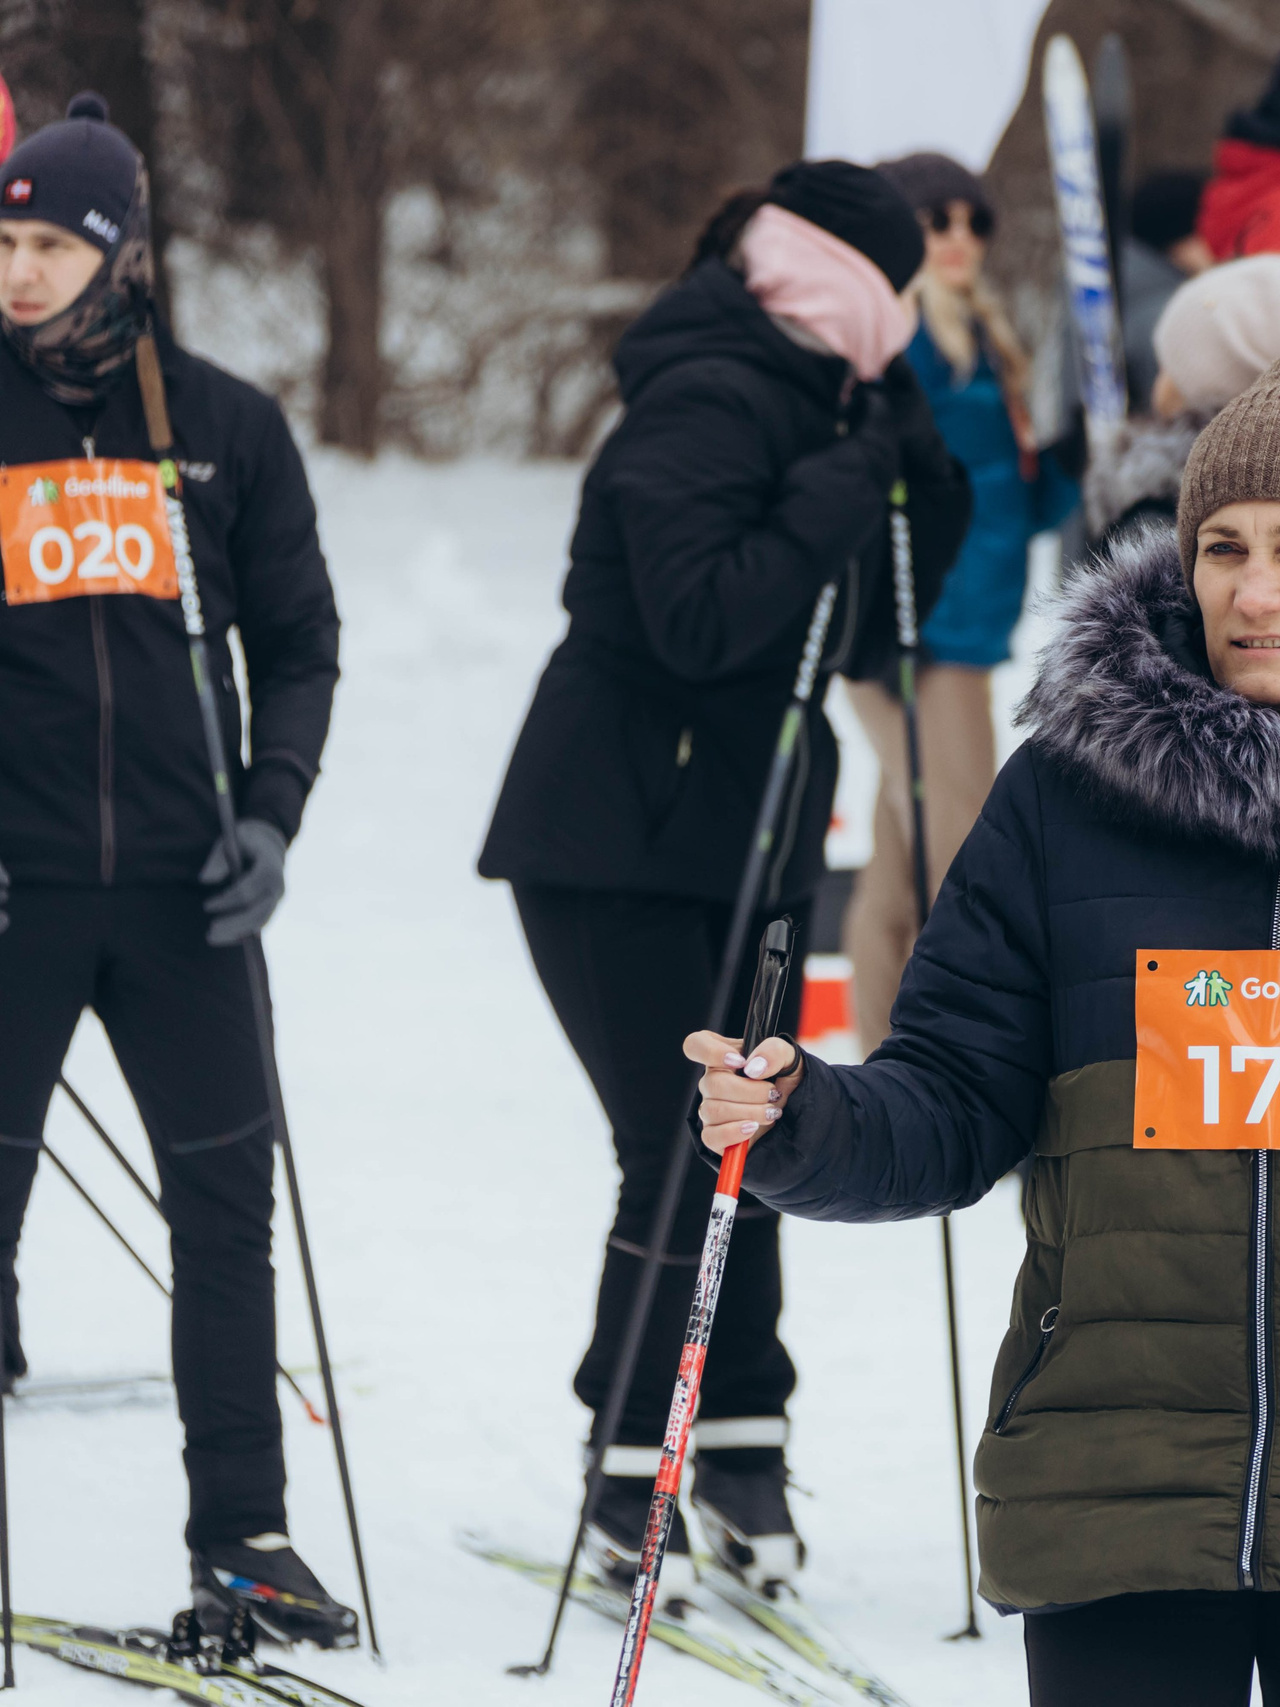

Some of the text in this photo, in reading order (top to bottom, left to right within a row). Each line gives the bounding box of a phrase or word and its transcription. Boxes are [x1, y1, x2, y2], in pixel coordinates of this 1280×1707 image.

[64, 475, 150, 499] Goodline
[29, 520, 155, 585] 020
[618, 1574, 647, 1678] FIBERGLASS
